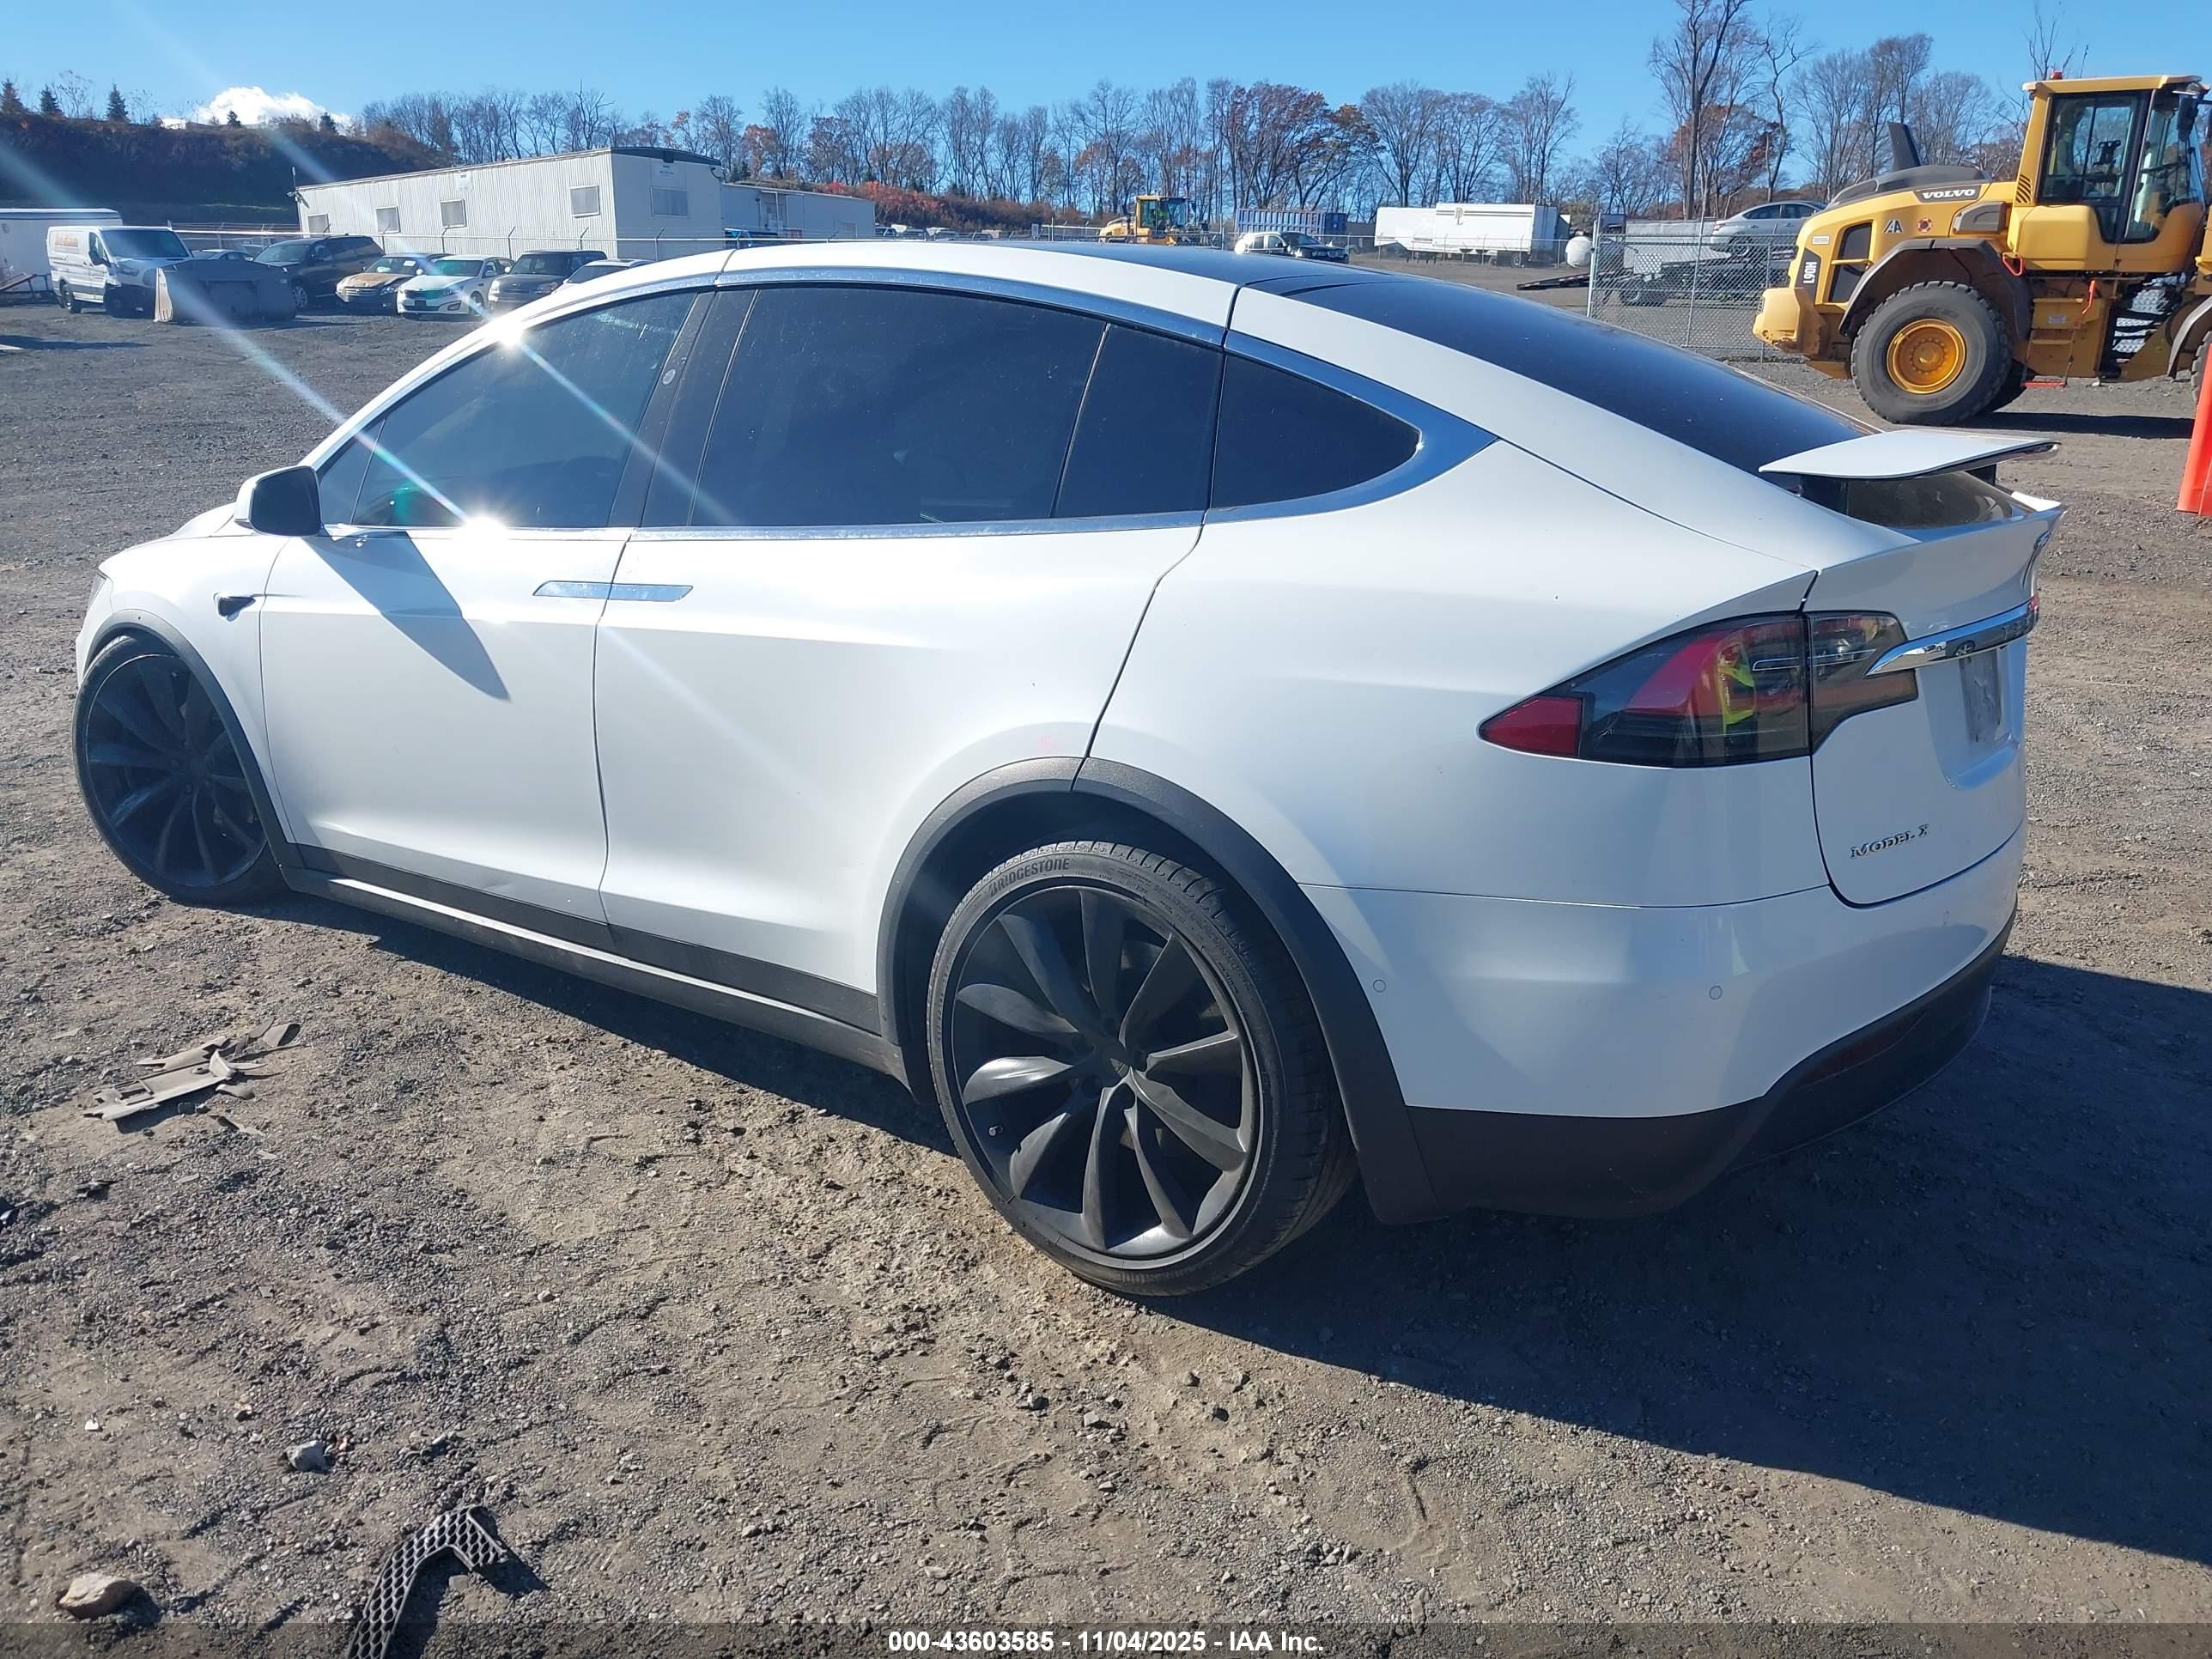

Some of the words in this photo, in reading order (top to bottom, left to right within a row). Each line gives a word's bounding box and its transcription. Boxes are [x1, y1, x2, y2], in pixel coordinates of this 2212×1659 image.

[1922, 189, 1976, 199] VOLVO
[1802, 261, 1818, 284] L90H
[1850, 830, 1916, 859] MODEL
[1917, 823, 1930, 837] X
[988, 858, 1071, 897] BRIDGESTONE
